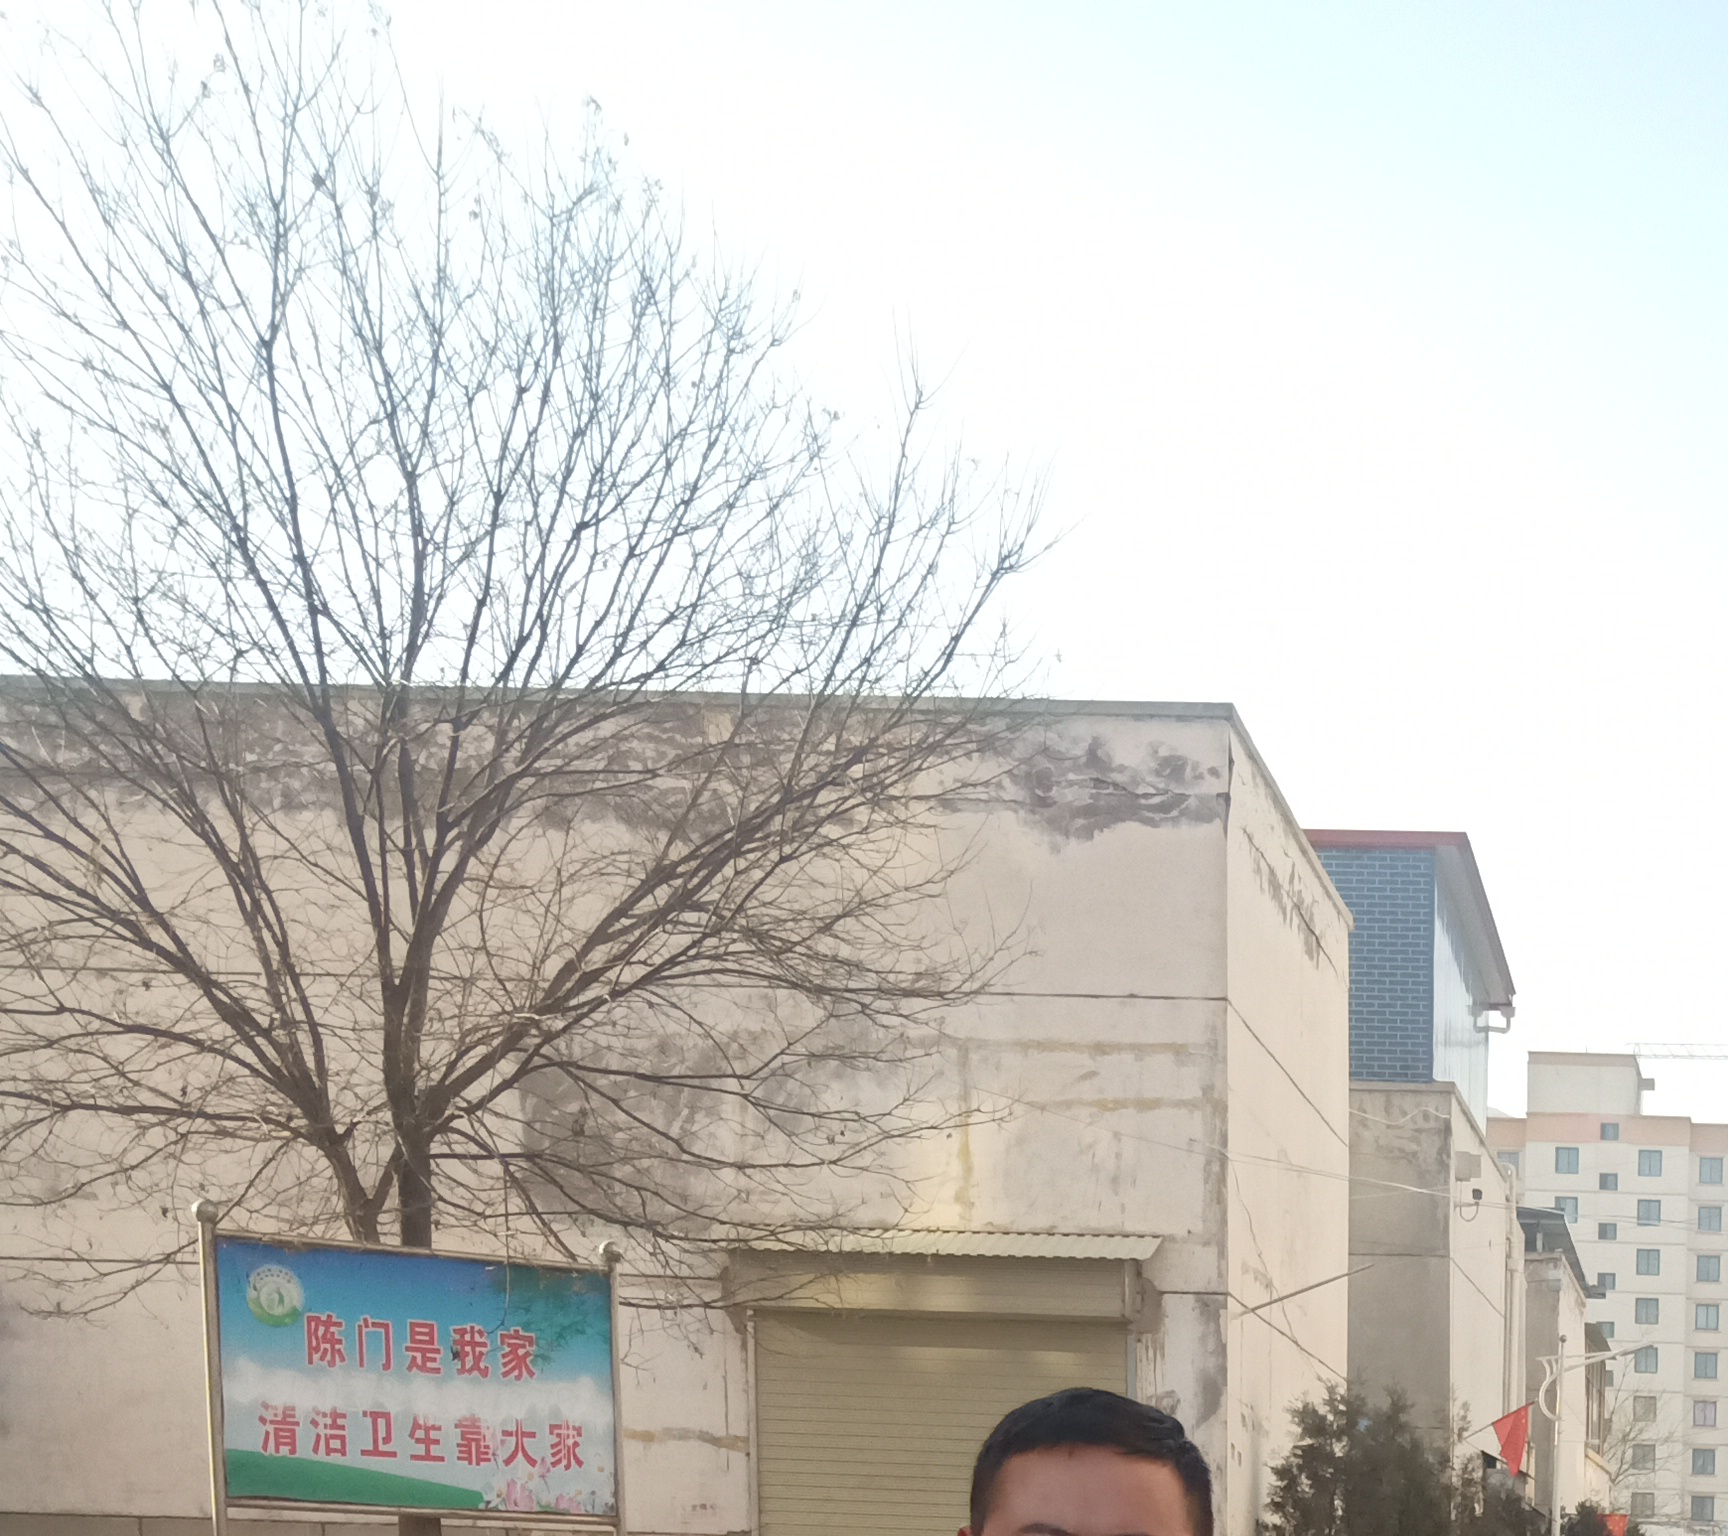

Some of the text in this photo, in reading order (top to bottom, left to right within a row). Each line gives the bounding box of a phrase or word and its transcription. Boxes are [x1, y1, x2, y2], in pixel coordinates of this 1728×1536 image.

[303, 1313, 537, 1382] 陈门是我家
[257, 1400, 585, 1472] 清洁卫生靠大家
